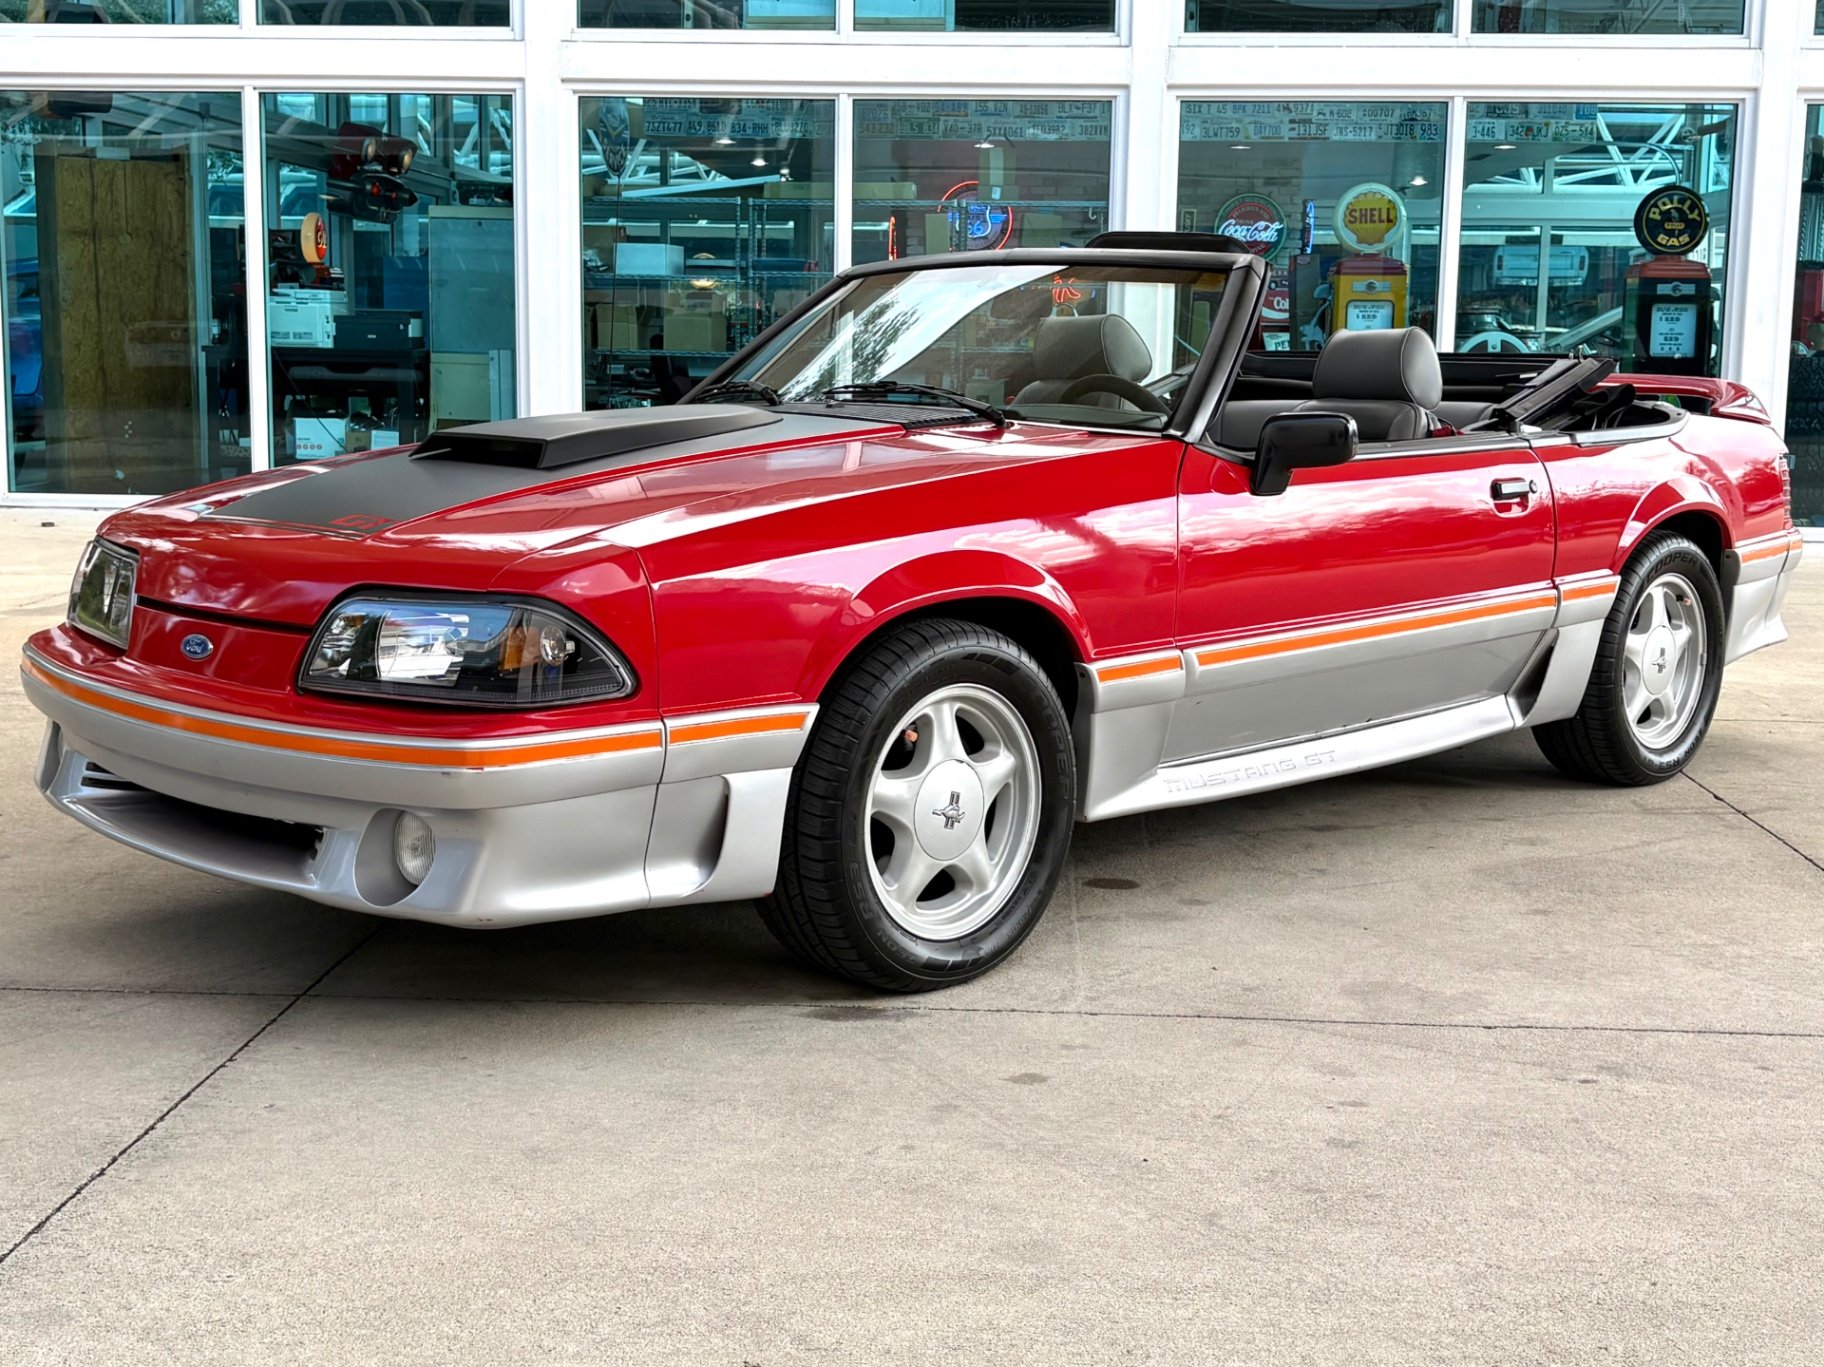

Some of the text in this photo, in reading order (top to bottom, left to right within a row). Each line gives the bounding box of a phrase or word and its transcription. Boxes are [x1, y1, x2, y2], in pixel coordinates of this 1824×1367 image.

[1348, 208, 1394, 225] SHELL
[1649, 195, 1701, 222] POLLY
[1218, 219, 1284, 242] Coca-Cola
[1657, 233, 1690, 247] GAS
[186, 638, 206, 653] Ford
[1164, 750, 1336, 793] MUSTANG GT
